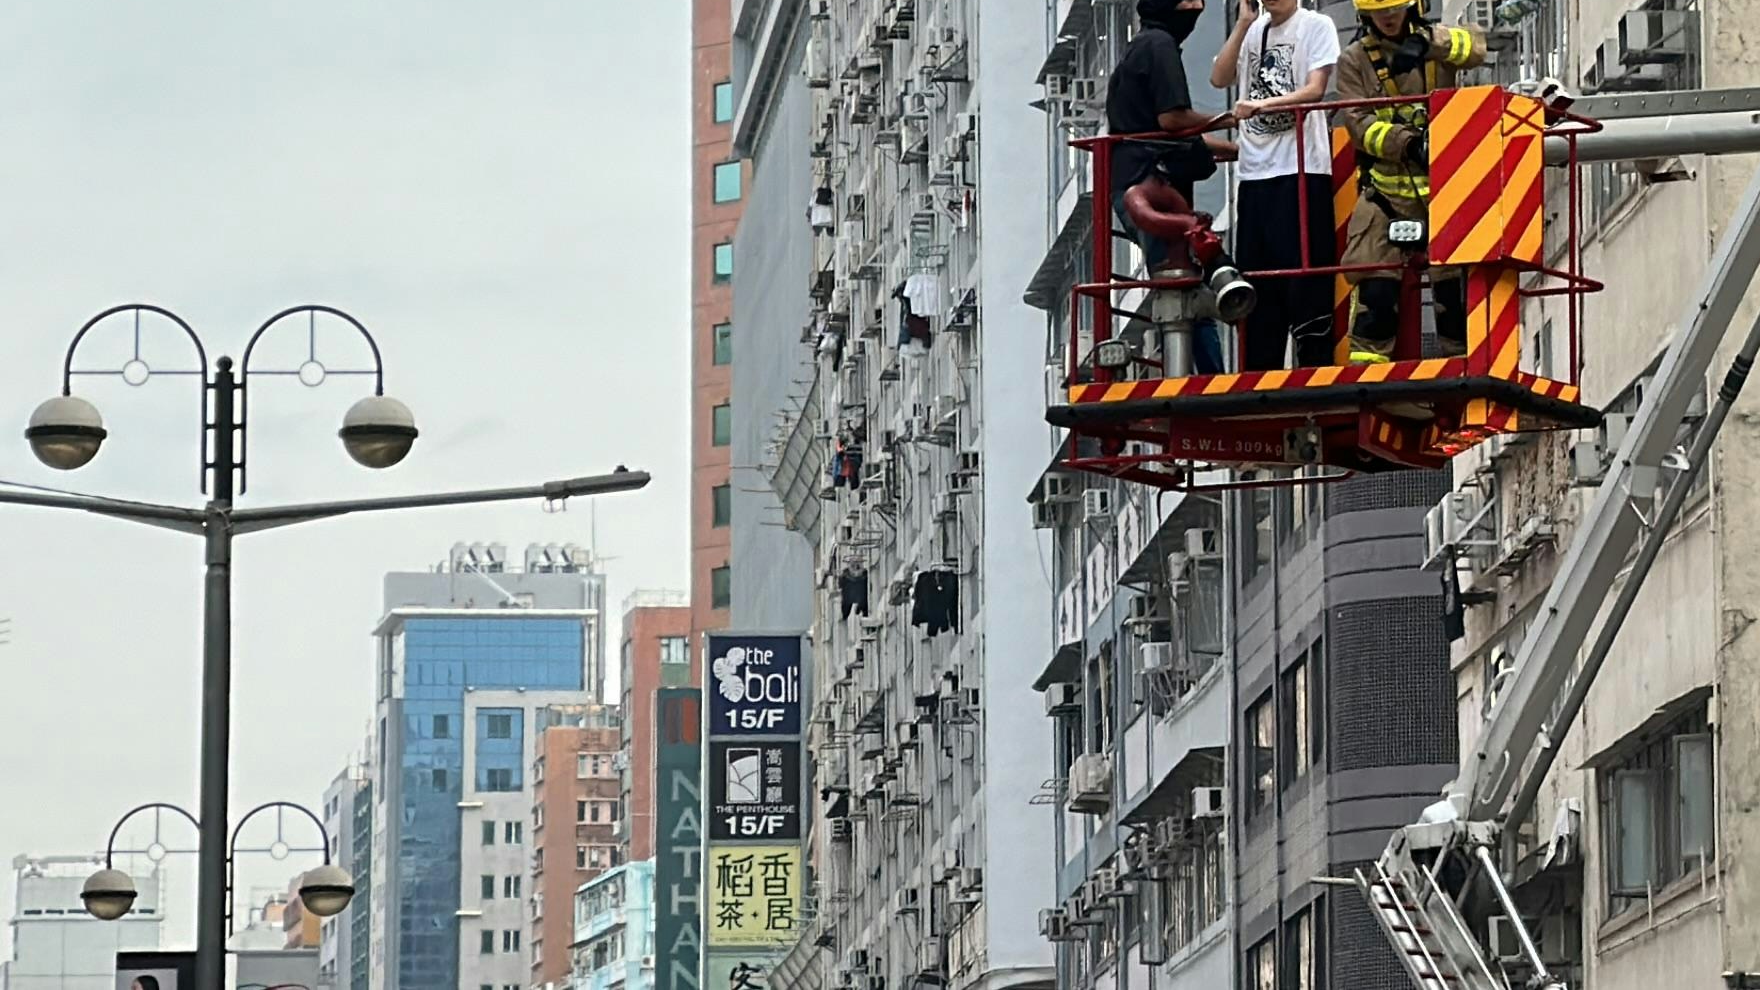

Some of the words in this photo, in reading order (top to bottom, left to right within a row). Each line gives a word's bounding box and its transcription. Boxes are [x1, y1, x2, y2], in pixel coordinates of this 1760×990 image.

[745, 647, 774, 665] the
[744, 666, 799, 703] bali
[725, 708, 785, 729] 15/F
[715, 805, 734, 814] THE
[736, 805, 796, 814] PENTHOUSE
[725, 815, 785, 835] 15/F
[669, 769, 701, 990] NATHAN
[716, 853, 794, 897] 稻香
